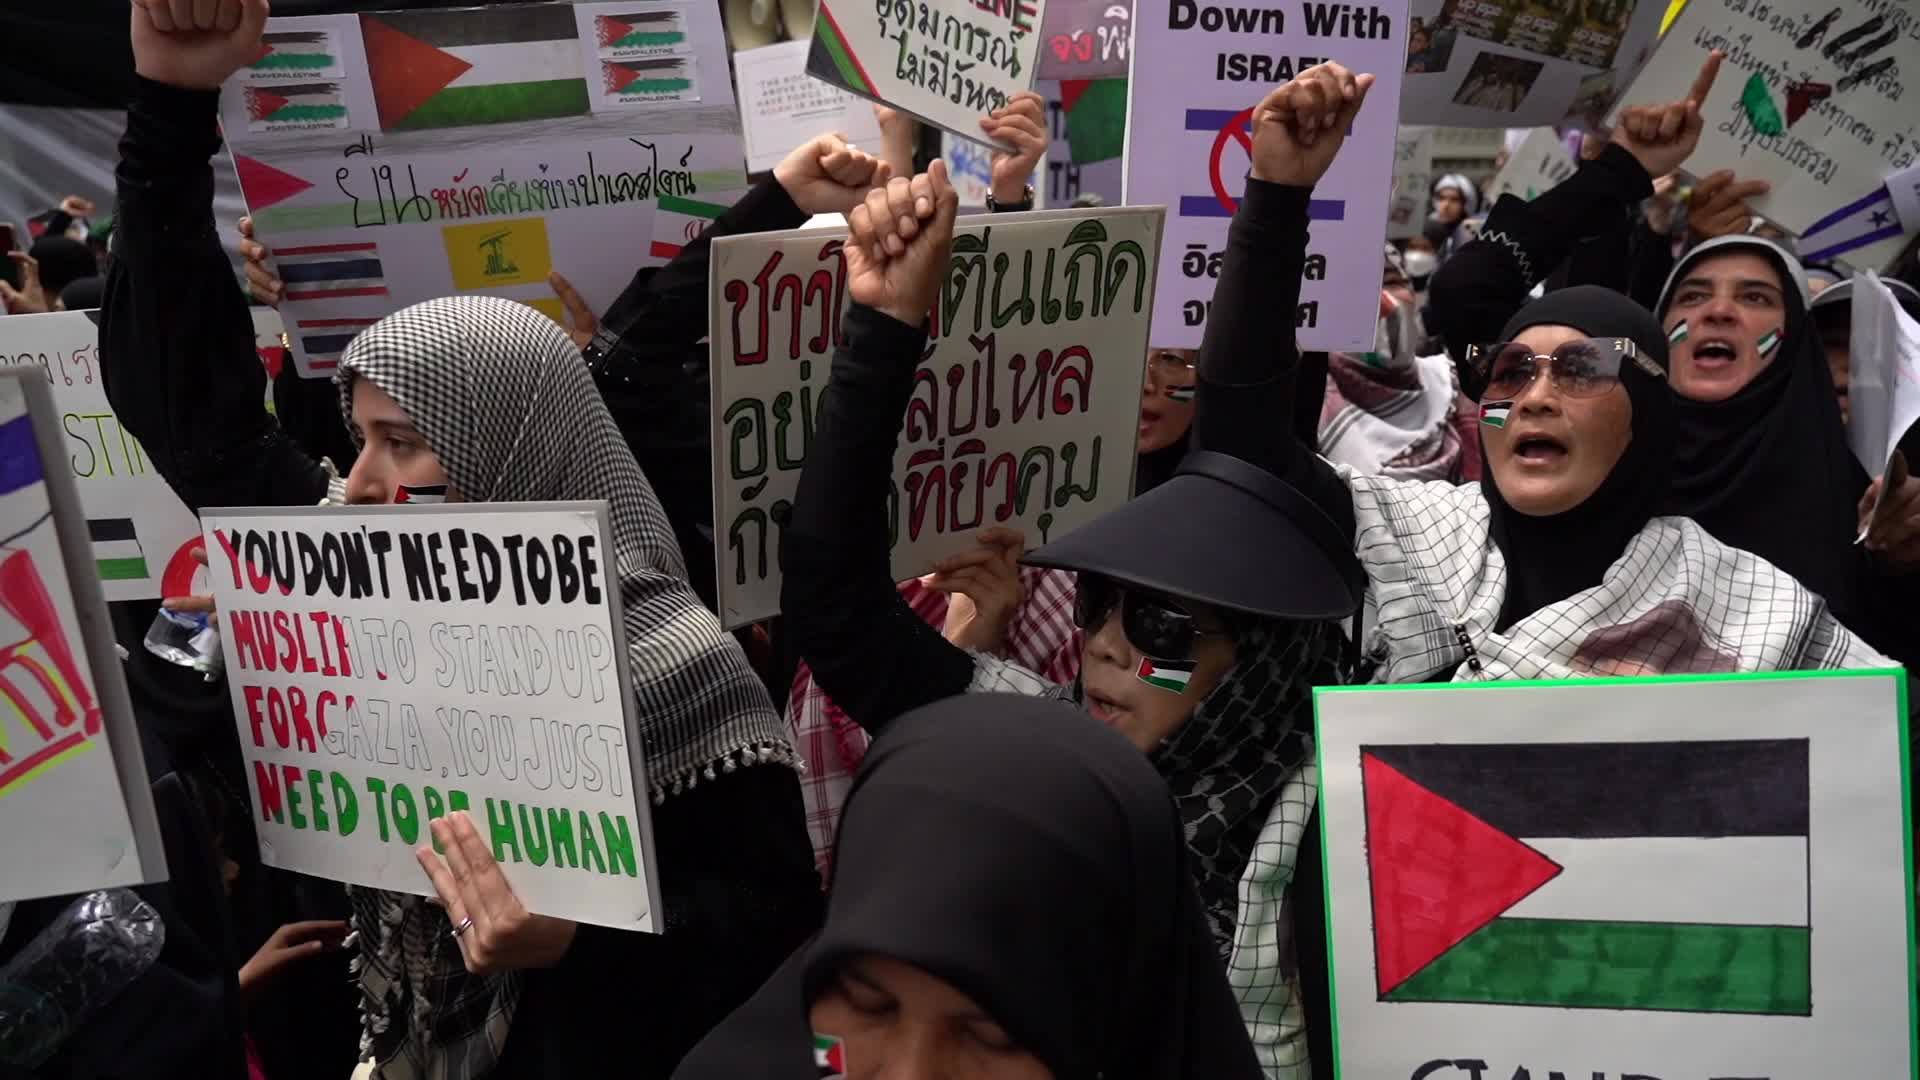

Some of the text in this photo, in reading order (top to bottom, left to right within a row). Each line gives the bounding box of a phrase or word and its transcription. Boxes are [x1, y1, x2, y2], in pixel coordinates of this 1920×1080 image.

[1168, 0, 1391, 40] Down With
[1216, 53, 1330, 83] ISRA
[214, 525, 602, 605] YOU DON'T NEED TO BE
[230, 610, 613, 703] MUSLIM TO STAND UP
[244, 685, 318, 753] FOR
[436, 707, 517, 781] YOU
[523, 717, 624, 797] JUST
[254, 761, 359, 836] NEED
[367, 776, 419, 845] TO
[485, 797, 637, 877] HUMAN
